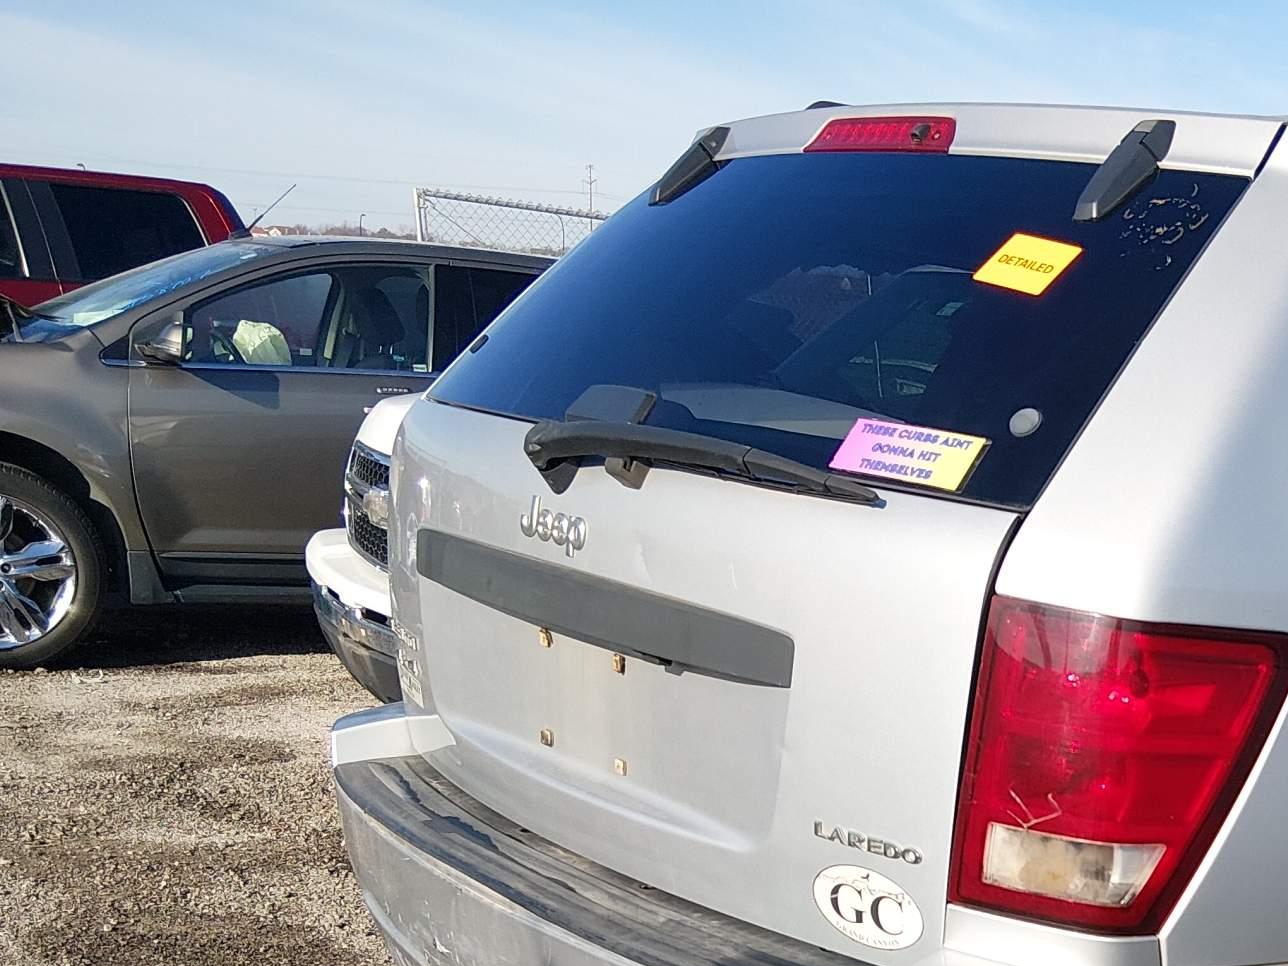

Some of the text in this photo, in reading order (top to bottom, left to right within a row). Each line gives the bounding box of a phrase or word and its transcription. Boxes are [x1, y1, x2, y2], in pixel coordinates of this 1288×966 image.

[998, 254, 1054, 274] DETAILED
[862, 423, 974, 450] THESE CURBS AINT
[872, 442, 941, 463] GONNA HIT
[859, 458, 933, 480] THEMSELVES
[520, 494, 587, 559] Jeep
[814, 820, 922, 865] LAREDO
[830, 882, 904, 936] GC
